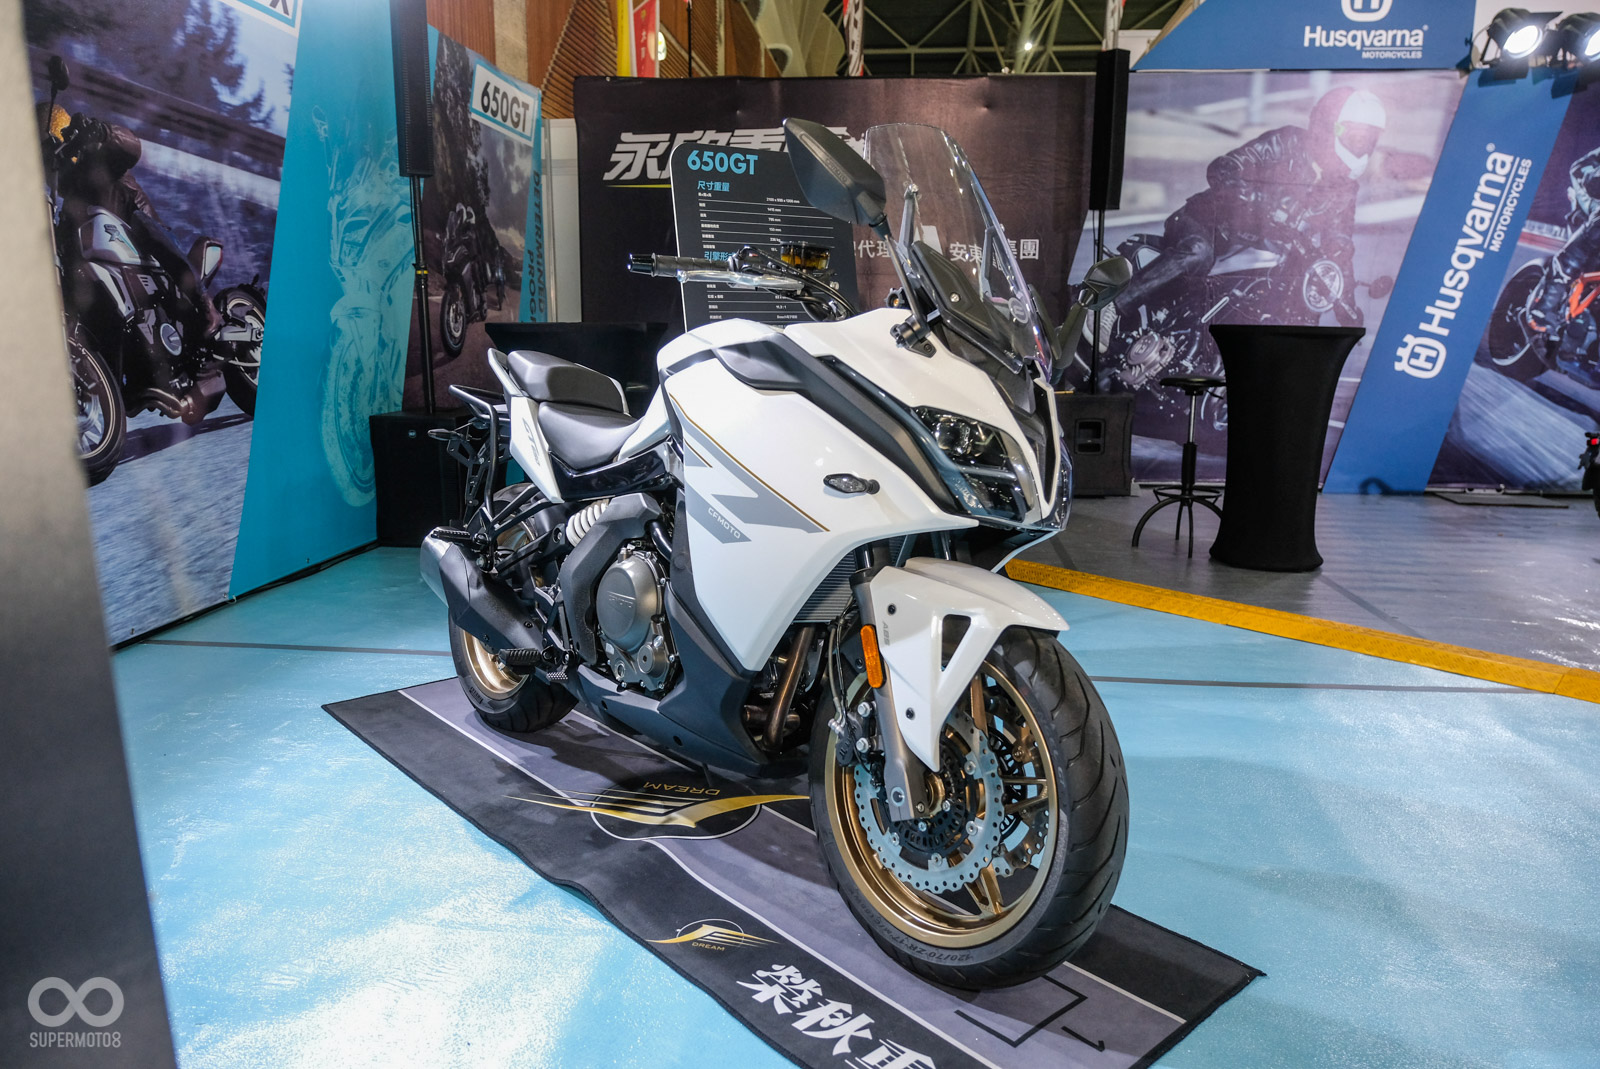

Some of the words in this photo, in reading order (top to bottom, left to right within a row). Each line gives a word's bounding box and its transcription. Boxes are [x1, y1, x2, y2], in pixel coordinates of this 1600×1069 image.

[1303, 25, 1424, 50] Husqvarna
[1362, 51, 1423, 59] MOTORCYCLES
[481, 81, 530, 133] 650GT
[687, 150, 759, 175] 650GT
[697, 181, 730, 192] 尺寸重量
[1489, 158, 1533, 252] MOTORCYCLES
[533, 169, 546, 313] DETERMINED
[853, 240, 891, 258] 代理
[1418, 150, 1515, 337] Husqvarna
[704, 251, 735, 261] 引擎形
[707, 507, 741, 539] CFMOTO
[643, 781, 721, 796] DREAM
[691, 941, 726, 951] DREAM
